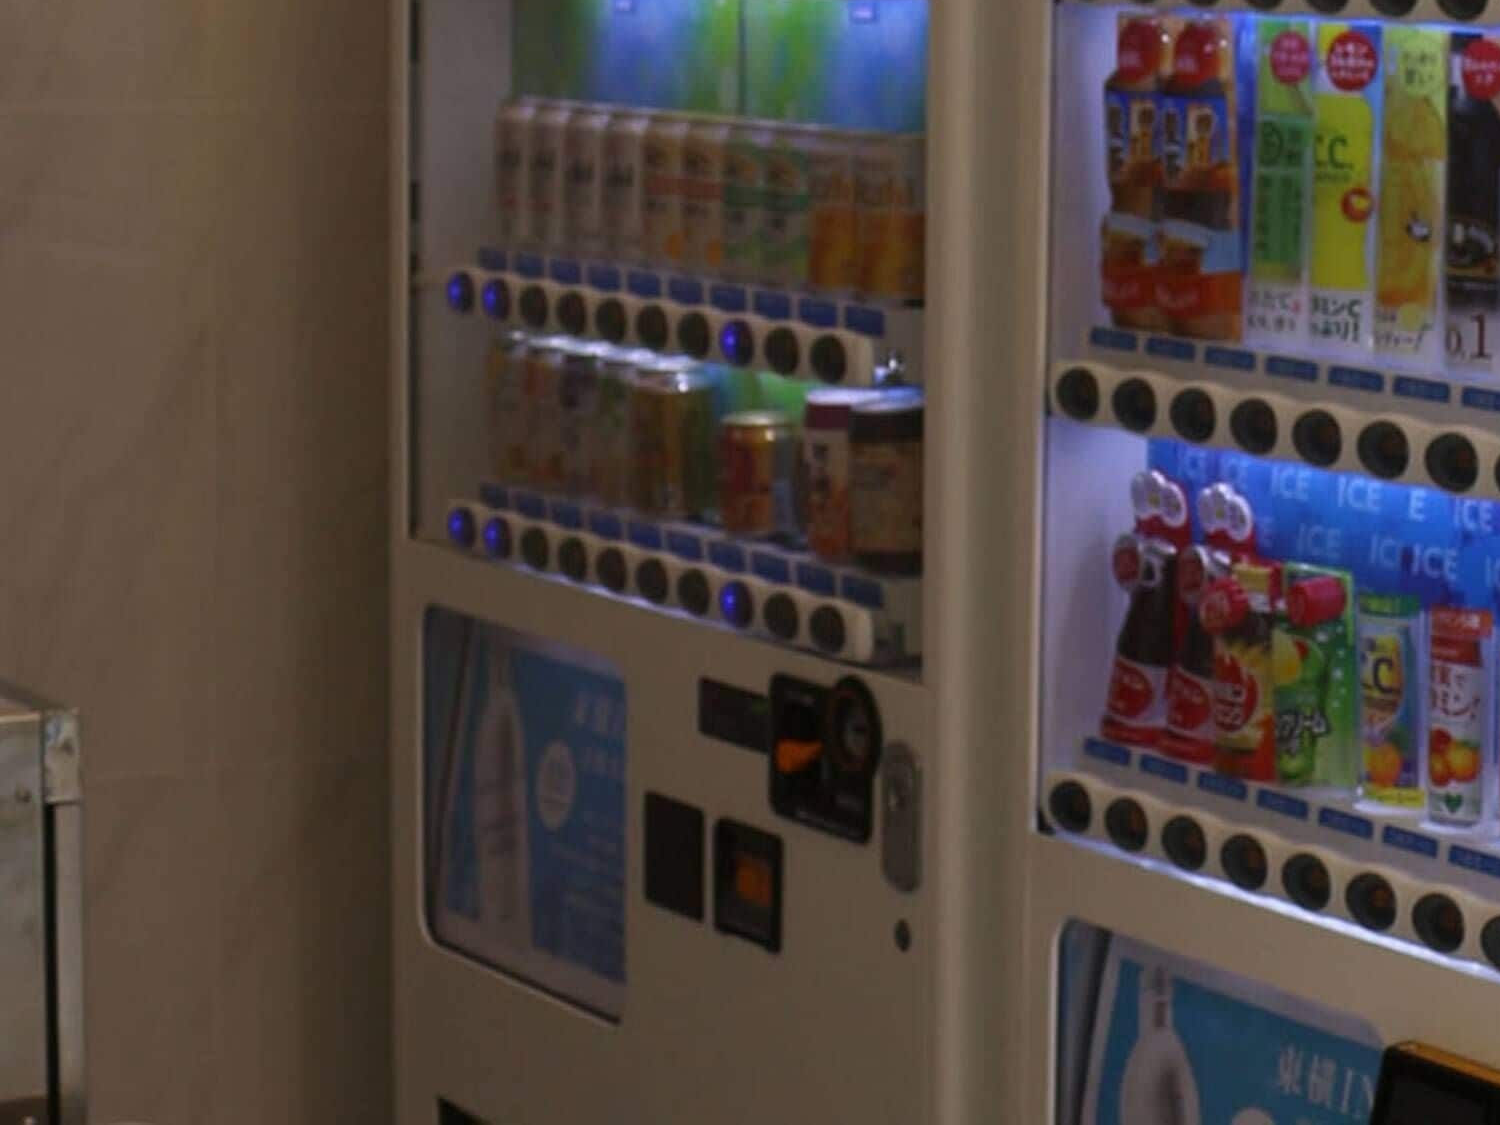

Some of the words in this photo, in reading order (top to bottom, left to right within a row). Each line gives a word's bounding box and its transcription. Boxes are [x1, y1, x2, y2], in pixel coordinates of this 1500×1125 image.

[1271, 464, 1310, 501] ICE
[1337, 475, 1384, 512] ICE
[1408, 487, 1427, 521] E
[1453, 497, 1494, 533] ICE
[1412, 543, 1460, 581] ICE
